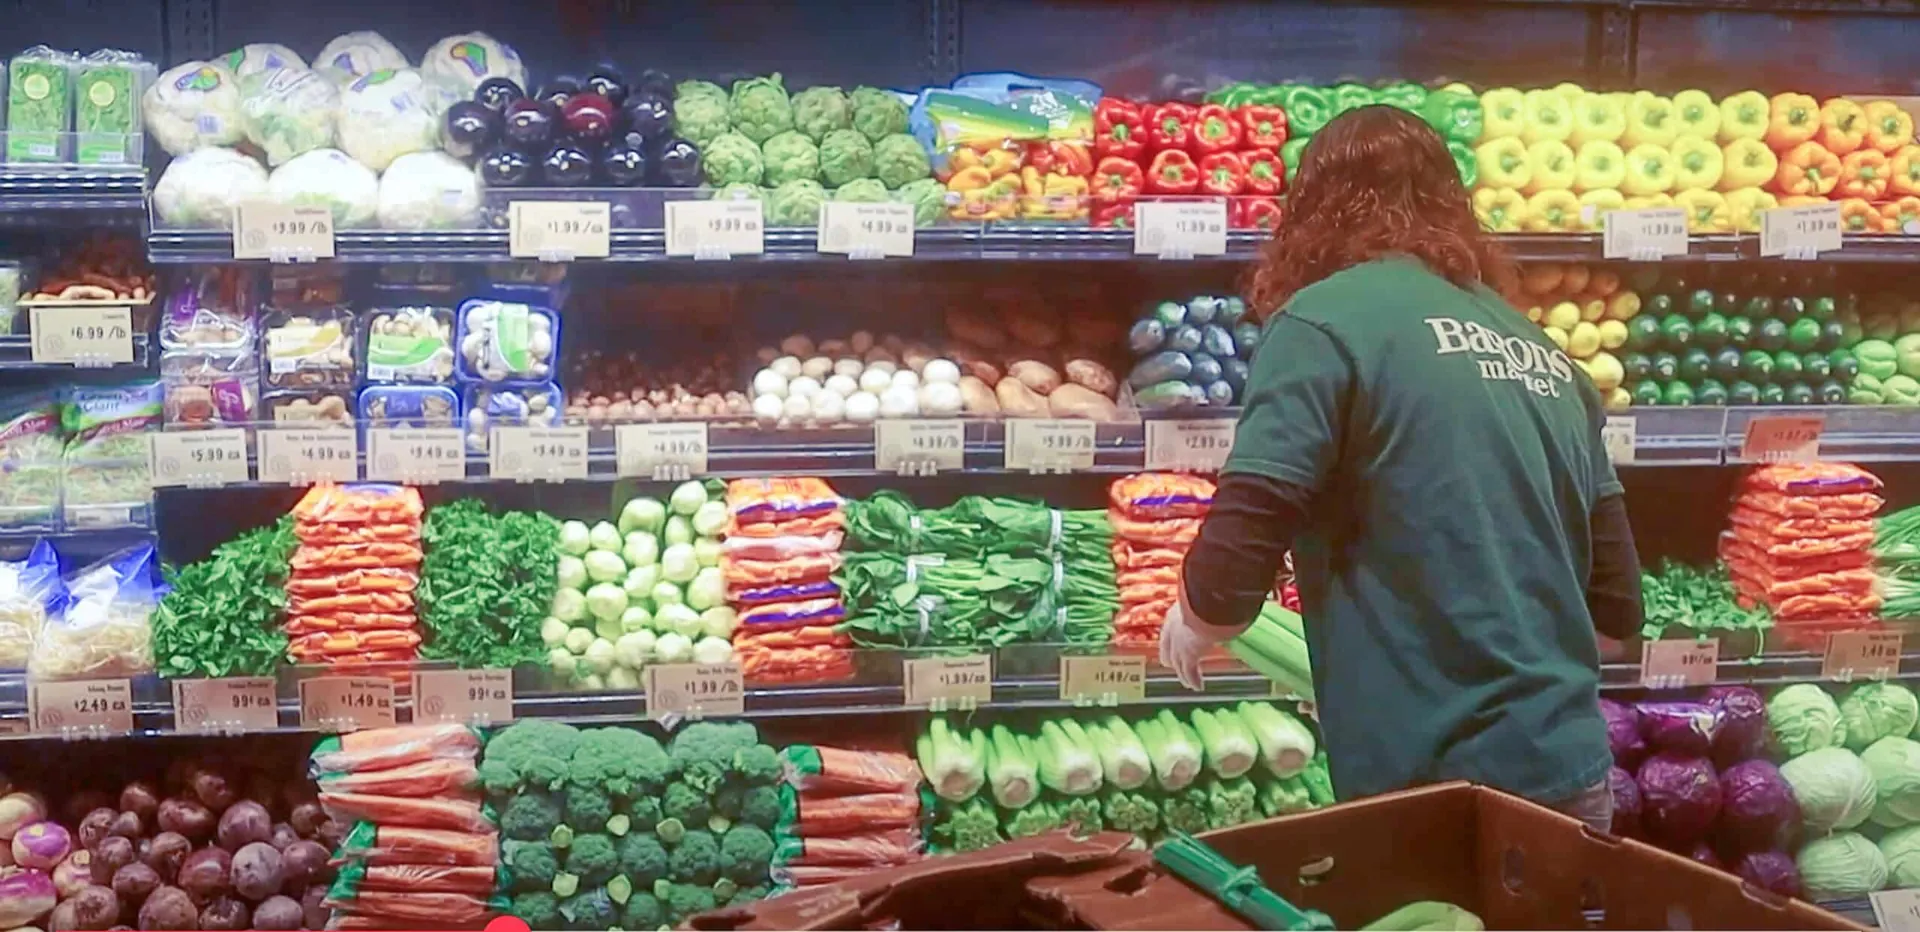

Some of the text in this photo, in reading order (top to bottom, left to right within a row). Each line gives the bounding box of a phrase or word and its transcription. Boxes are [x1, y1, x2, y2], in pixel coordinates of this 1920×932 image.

[71, 325, 126, 340] $6.99 /lb
[1476, 359, 1560, 398] maket
[74, 698, 108, 713] $2.49
